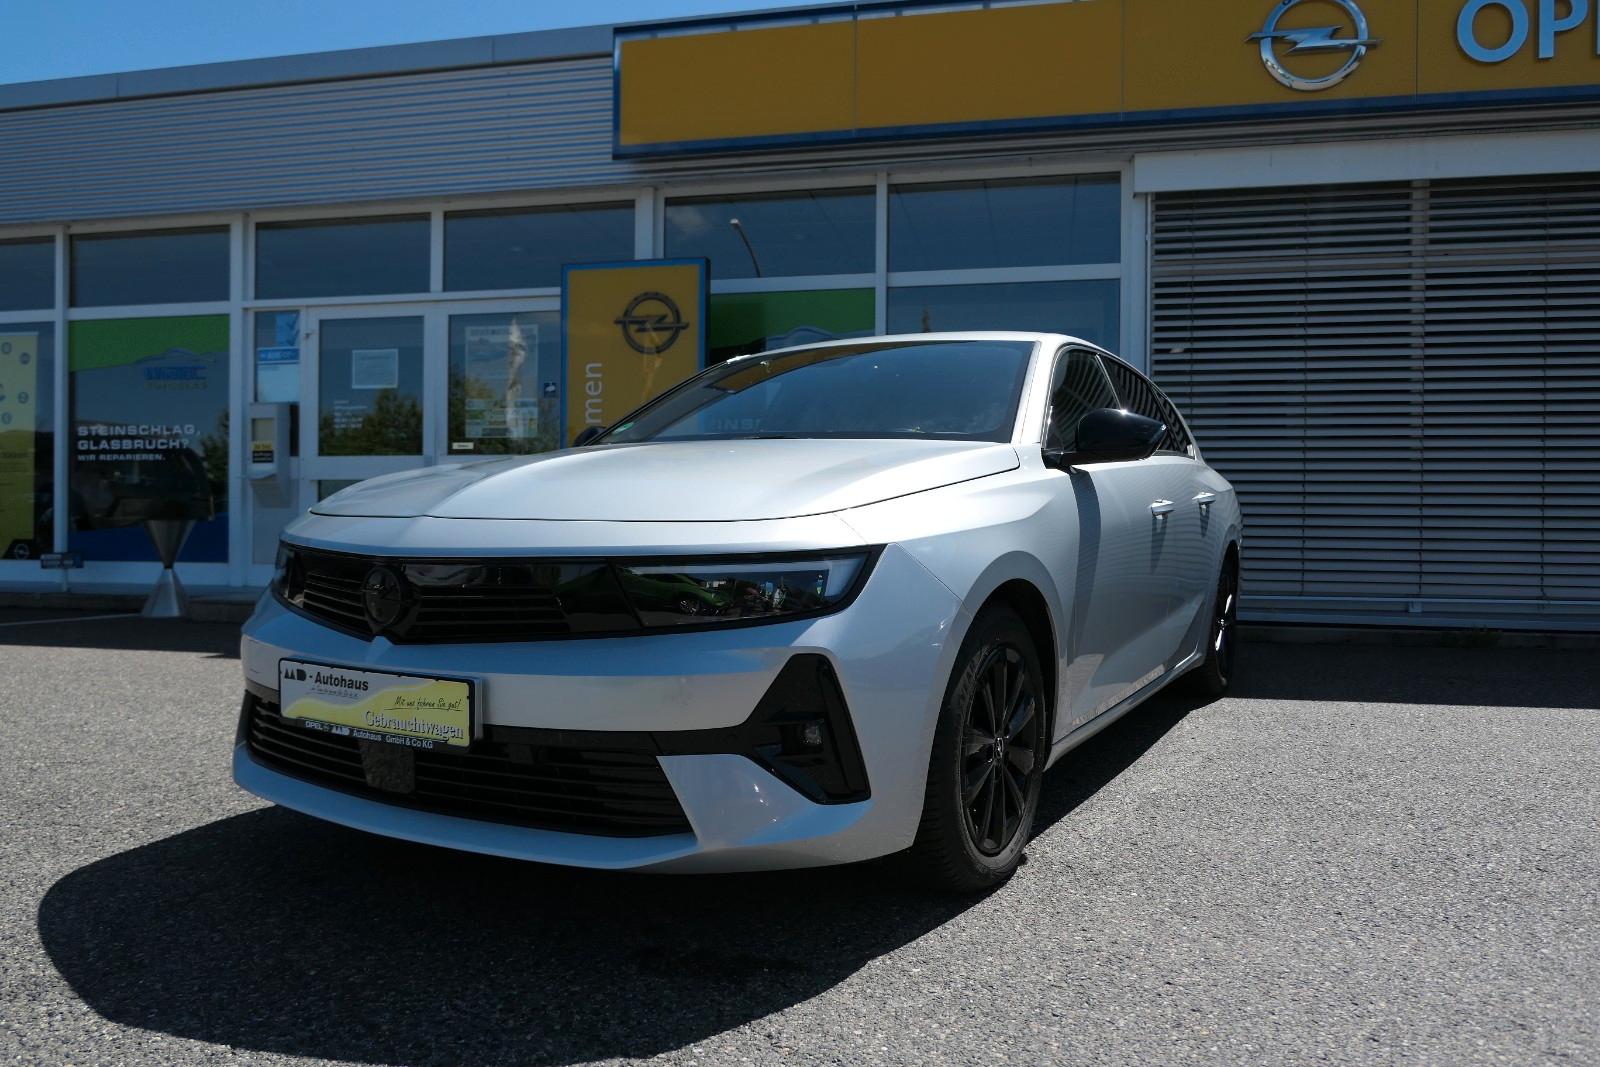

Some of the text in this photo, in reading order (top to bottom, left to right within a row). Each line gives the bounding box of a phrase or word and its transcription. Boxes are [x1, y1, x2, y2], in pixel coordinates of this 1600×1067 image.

[1457, 0, 1600, 63] OP
[585, 363, 602, 424] men
[77, 424, 201, 437] STEINSCHLAG,
[78, 438, 189, 450] GLASBRUCH?
[78, 454, 96, 462] WIR
[315, 671, 369, 691] Autohaus
[365, 711, 464, 741] Gebrauchtwagen
[353, 729, 382, 741] Autohaus
[385, 735, 405, 745] GmbH
[412, 738, 421, 747] Co
[422, 739, 433, 749] KG
